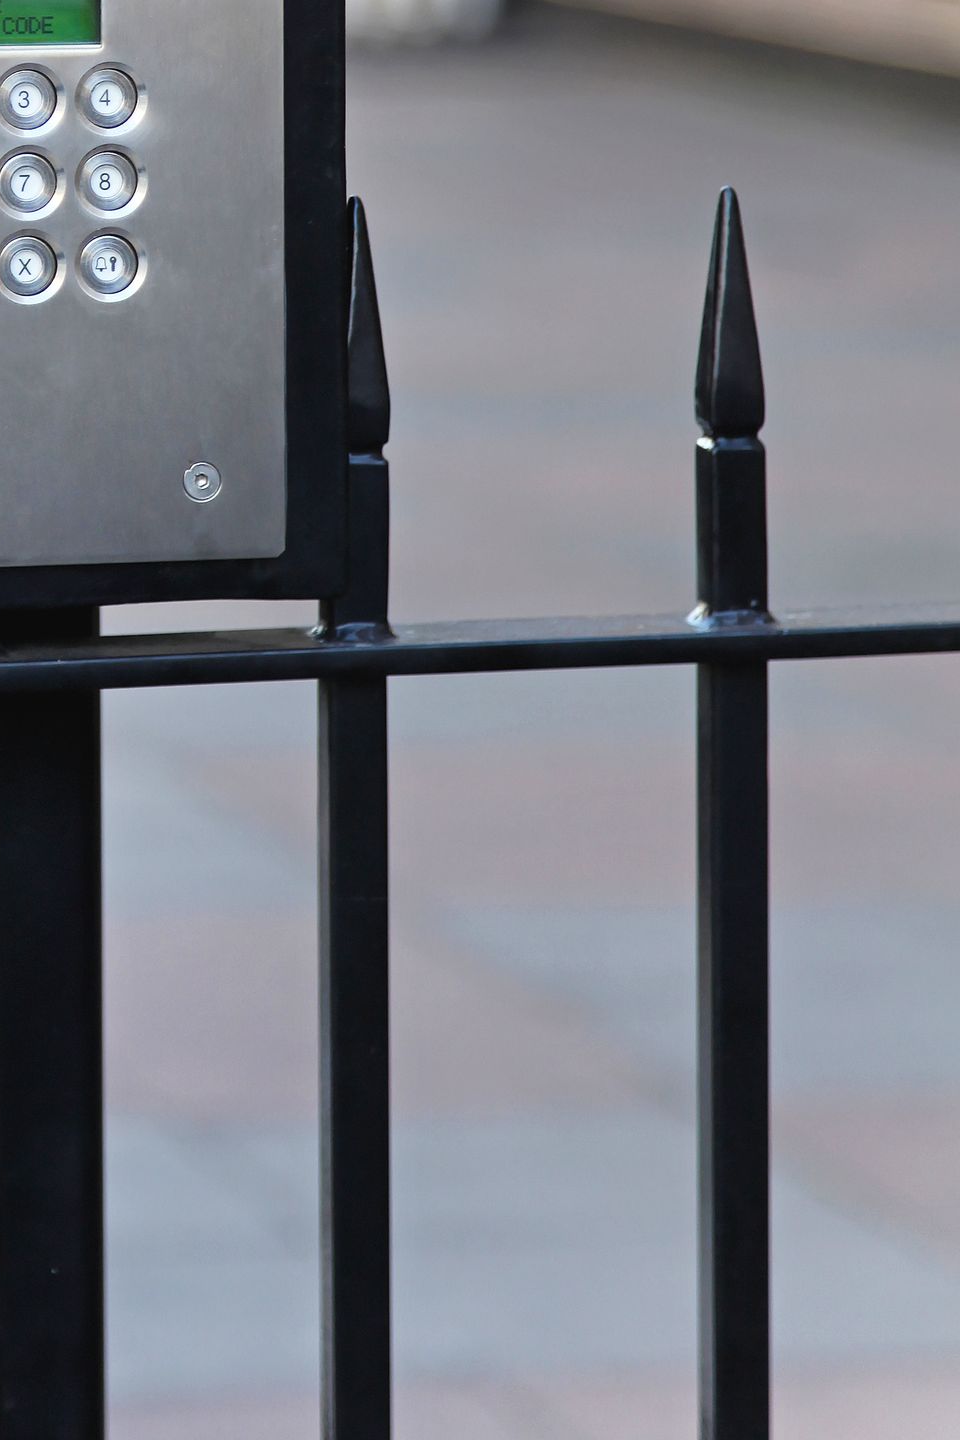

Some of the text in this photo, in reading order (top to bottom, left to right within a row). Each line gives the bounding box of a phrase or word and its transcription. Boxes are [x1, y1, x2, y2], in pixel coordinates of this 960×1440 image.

[3, 16, 54, 34] CODE
[18, 90, 30, 108] 3
[98, 89, 111, 106] 4
[19, 174, 31, 192] 7
[98, 173, 111, 191] 8
[18, 258, 31, 276] X
